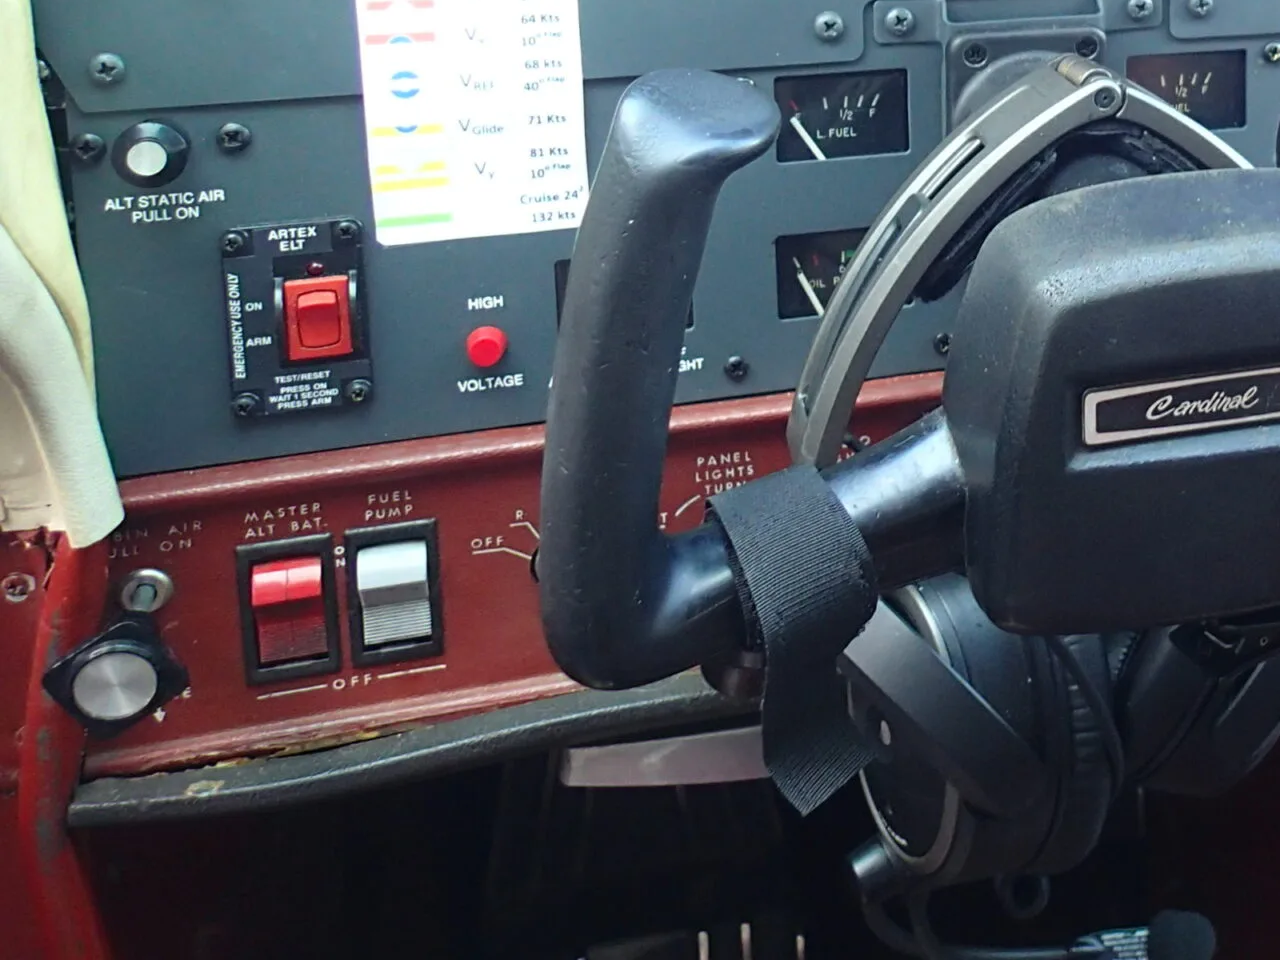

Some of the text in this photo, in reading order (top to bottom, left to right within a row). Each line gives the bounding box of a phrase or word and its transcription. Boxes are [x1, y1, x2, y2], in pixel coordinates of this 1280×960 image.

[828, 128, 857, 138] FUEL
[104, 188, 225, 211] ALT STATIC AIR
[520, 194, 559, 205] Cruise
[132, 206, 200, 224] PULL ON
[268, 226, 317, 240] ARTEX
[279, 240, 306, 252] ELT
[245, 302, 263, 312] ON
[467, 295, 504, 310] HIGH
[227, 273, 246, 379] EMERGENCY USE ONLY
[246, 336, 272, 348] ARM
[274, 370, 331, 384] TEST/RESET
[457, 373, 525, 393] VOLTAGE
[269, 388, 339, 404] WAIT SECOND
[280, 382, 327, 394] PRESS ON
[277, 397, 332, 410] PRESS ARM
[1146, 386, 1259, 420] Cardinal
[697, 451, 751, 467] PANEL
[695, 465, 755, 483] LIGHTS
[367, 490, 413, 506] FUEL
[244, 502, 323, 524] MASTER
[364, 504, 414, 522] PUMP
[515, 509, 525, 521] R
[168, 520, 203, 536] AIR
[244, 524, 277, 540] ALT
[159, 538, 193, 553] ON
[470, 536, 506, 549] OFF
[332, 672, 374, 690] OFF
